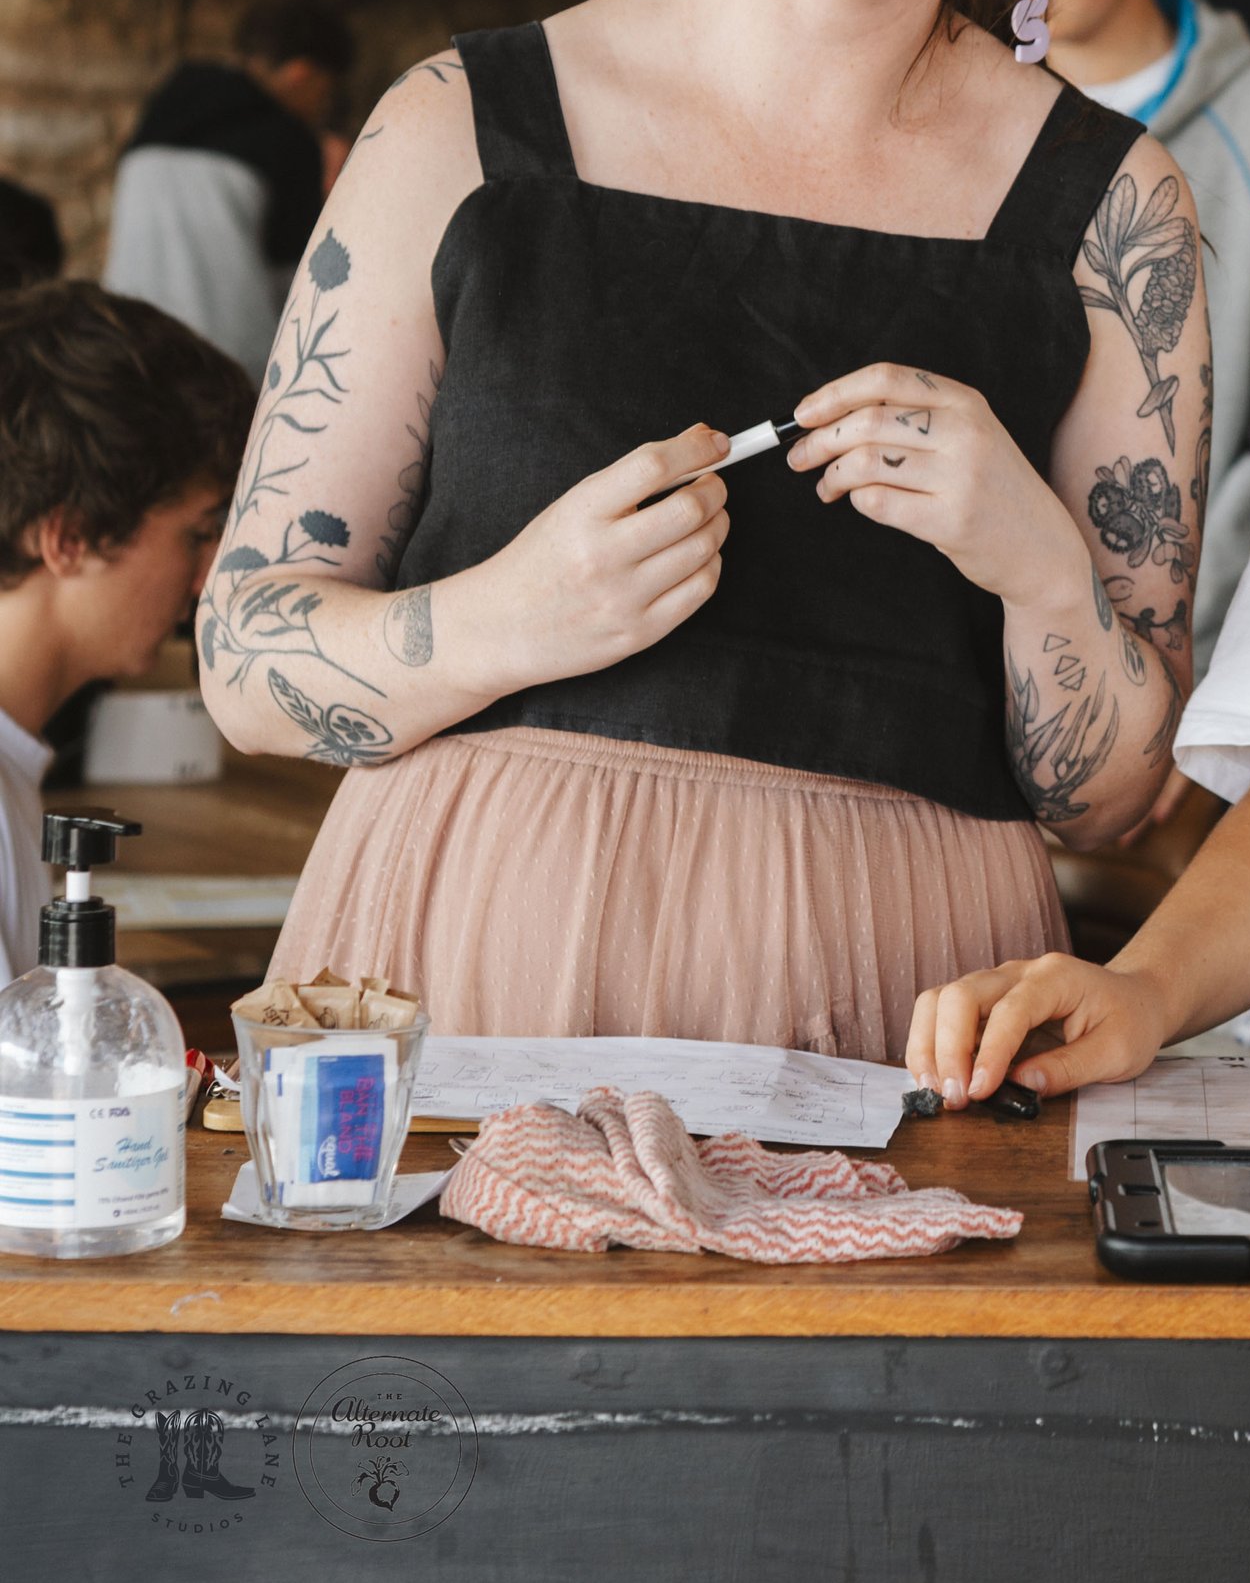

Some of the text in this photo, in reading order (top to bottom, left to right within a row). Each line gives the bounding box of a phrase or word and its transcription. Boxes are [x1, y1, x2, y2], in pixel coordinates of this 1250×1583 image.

[338, 1090, 354, 1154] BLAND
[93, 1147, 169, 1172] Sanitizer Gel
[116, 1135, 154, 1154] Hand
[318, 1135, 341, 1177] equal
